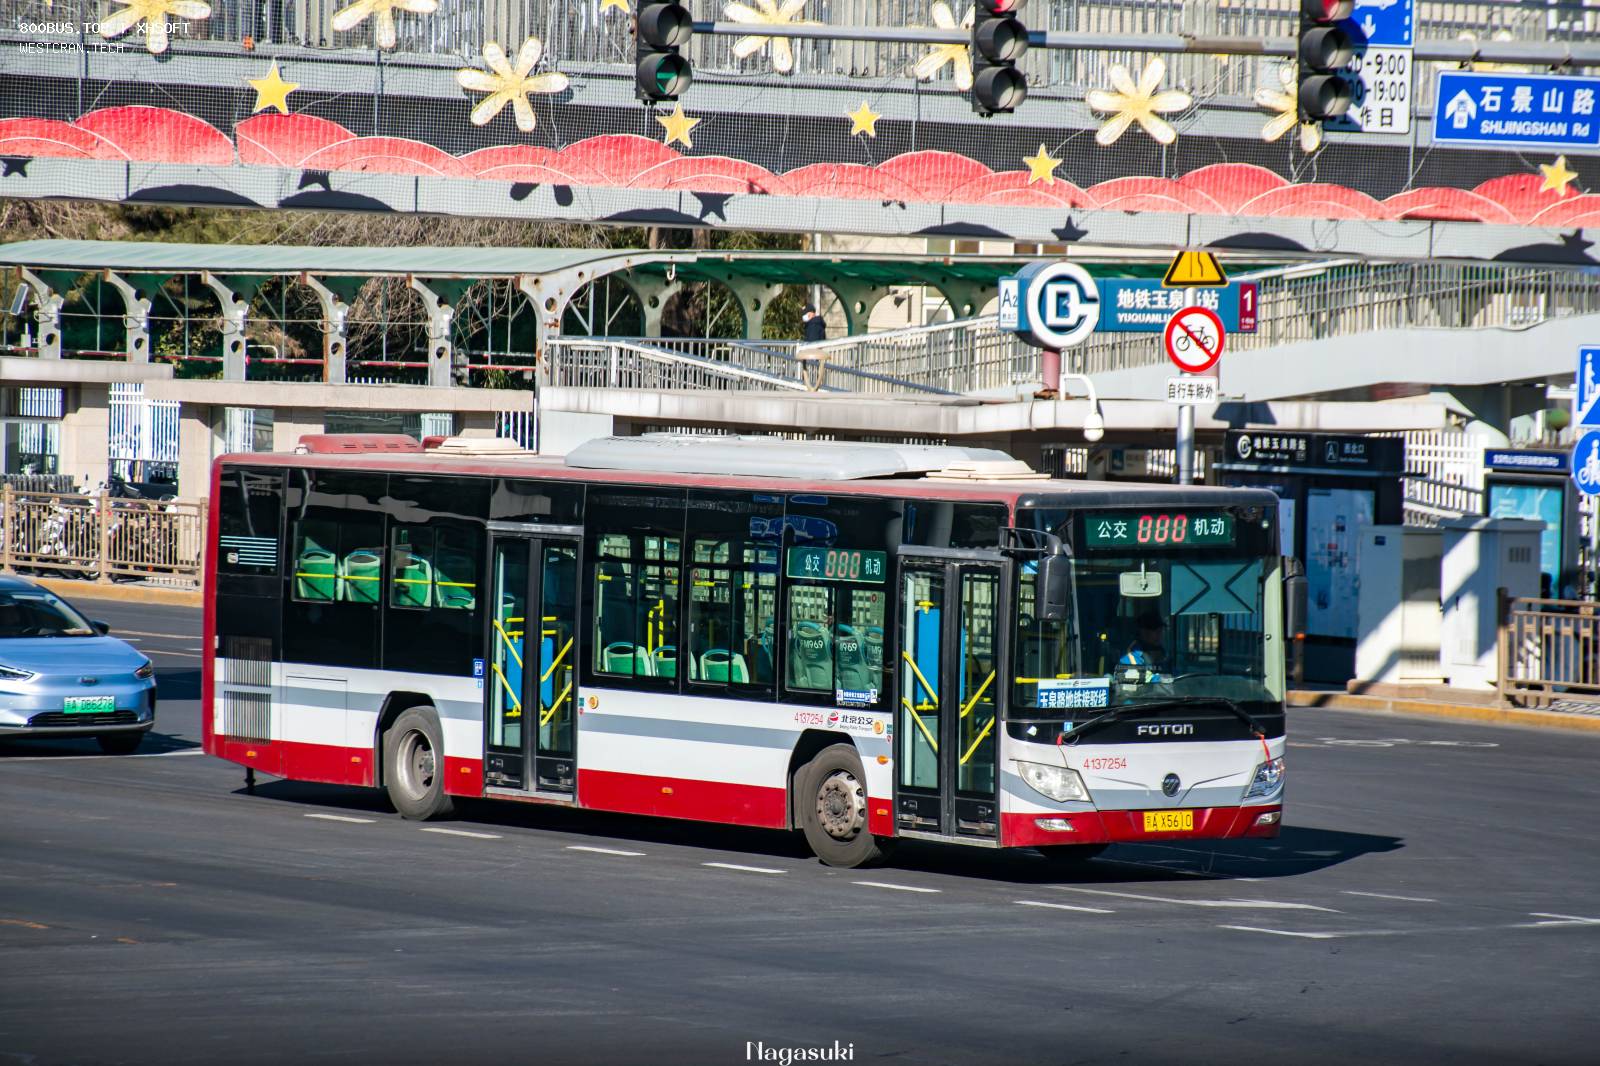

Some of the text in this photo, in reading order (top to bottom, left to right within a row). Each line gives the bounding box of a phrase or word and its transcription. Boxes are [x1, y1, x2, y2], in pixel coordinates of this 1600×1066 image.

[1480, 86, 1596, 115] 石景山路
[1480, 119, 1567, 137] SHIJINGSHAN
[1571, 122, 1590, 137] Rd
[1001, 287, 1019, 308] A2
[1117, 288, 1220, 310] 地铁玉泉站
[1243, 289, 1253, 312] 1
[1168, 382, 1213, 399] 自行车除外
[1097, 521, 1128, 539] 公交
[1194, 518, 1225, 536] 机动
[805, 554, 820, 572] 公交
[865, 557, 881, 575] 机动
[794, 711, 824, 725] 4137254
[840, 714, 873, 726] 北京公交
[1137, 723, 1194, 735] FOTON
[1083, 757, 1128, 770] 4137254
